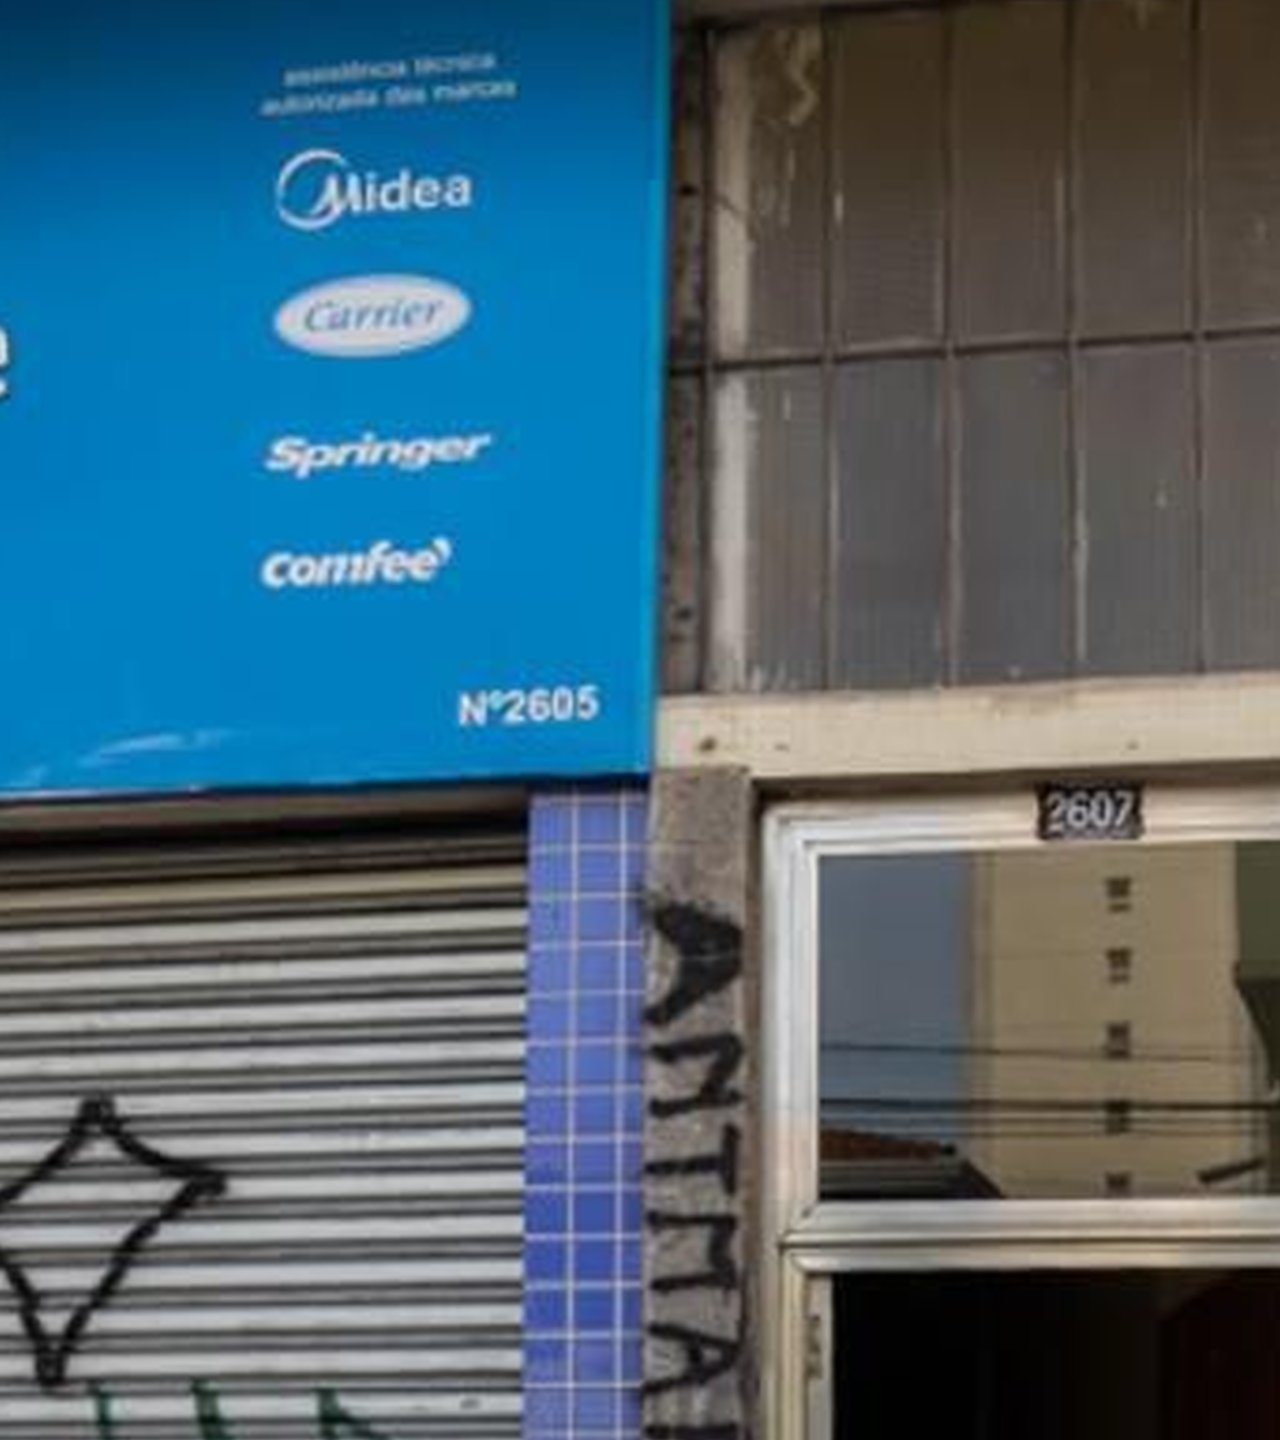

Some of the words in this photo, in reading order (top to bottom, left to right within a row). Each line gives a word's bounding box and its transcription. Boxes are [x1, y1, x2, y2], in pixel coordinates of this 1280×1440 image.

[292, 158, 473, 222] Midea
[302, 297, 443, 333] Carrier
[264, 430, 493, 480] Springer
[1046, 789, 1135, 834] 2607
